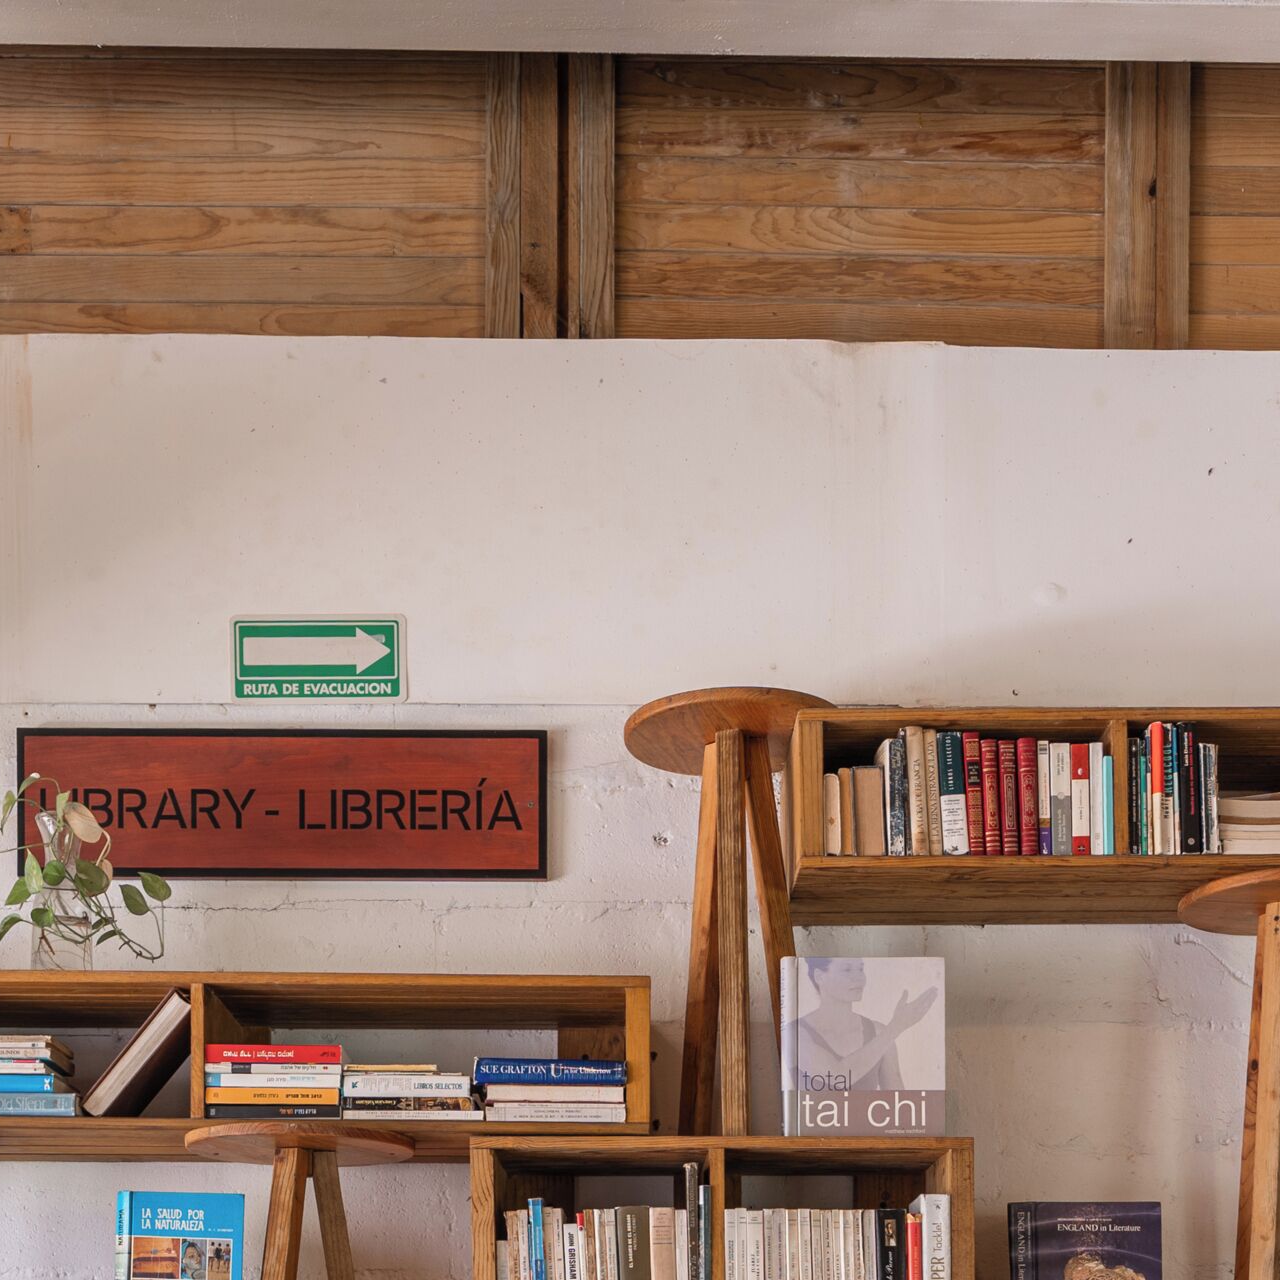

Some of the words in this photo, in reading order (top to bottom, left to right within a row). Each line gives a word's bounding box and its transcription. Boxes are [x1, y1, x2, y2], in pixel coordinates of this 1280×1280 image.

[243, 683, 278, 696] RUTA
[281, 683, 300, 696] DE
[303, 682, 393, 695] EVACUACION
[913, 759, 921, 791] FRANCIA
[927, 741, 937, 801] ESTRANGULADA
[299, 779, 524, 831] LIBRERÍA
[930, 803, 938, 825] REINA
[480, 1065, 499, 1074] SUE
[500, 1064, 546, 1074] GRAFTON
[551, 1064, 562, 1078] U
[579, 1066, 611, 1074] Undertow
[802, 1069, 852, 1091] total
[16, 1098, 46, 1110] Silent
[802, 1091, 849, 1127] tai
[867, 1091, 926, 1127] chi
[142, 1208, 152, 1218] LA
[157, 1208, 182, 1219] SALUD
[188, 1209, 204, 1220] POR
[142, 1219, 151, 1229] LA
[155, 1220, 204, 1231] NATURALEZA
[932, 1222, 942, 1252] Tackle!
[1017, 1211, 1025, 1254] ENGLAND
[1057, 1224, 1099, 1232] ENGLAND
[1100, 1224, 1107, 1232] in
[1108, 1224, 1141, 1232] Literature
[568, 1248, 577, 1280] GRISHAM
[1017, 1254, 1024, 1263] in
